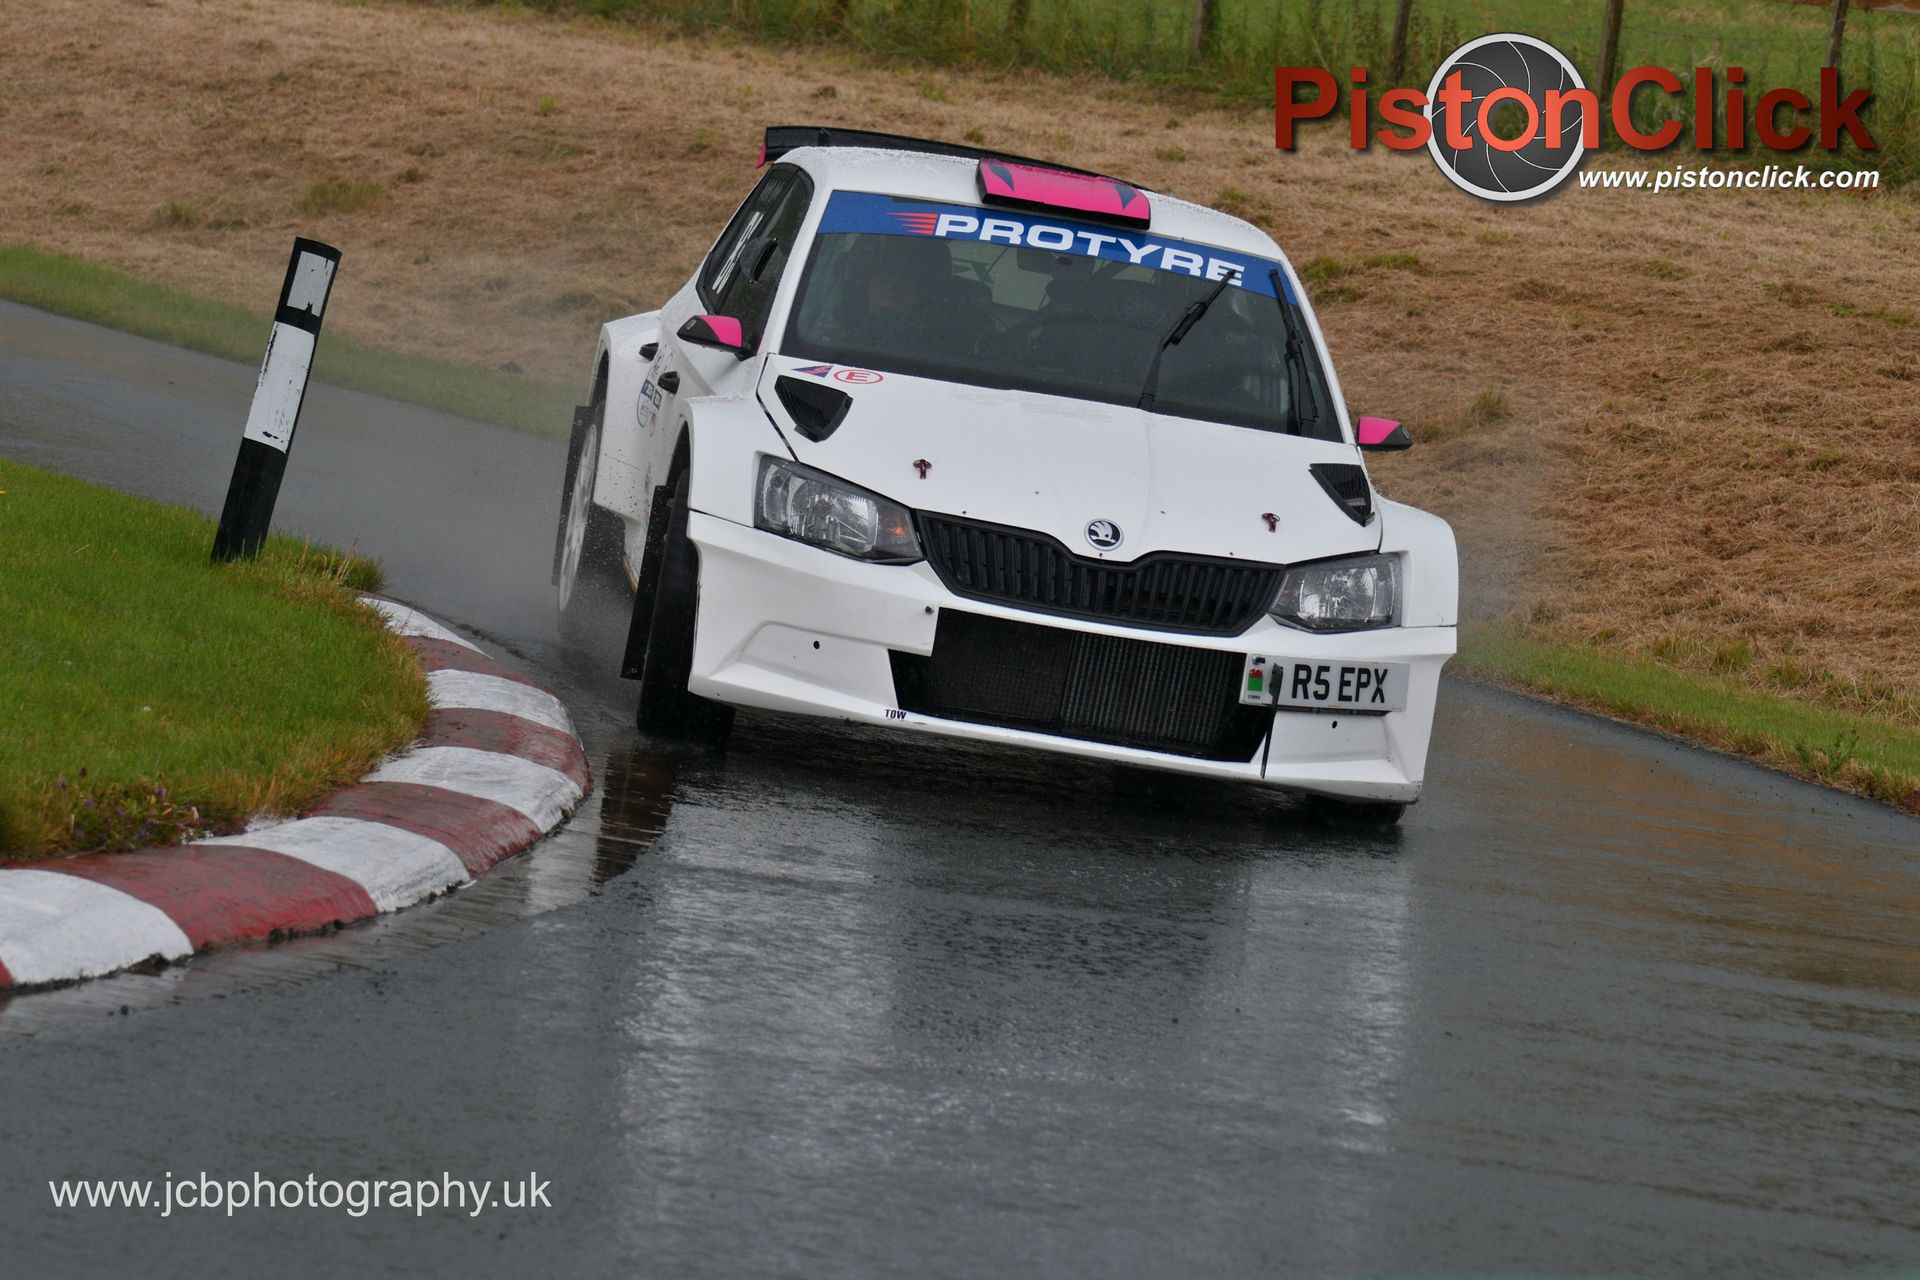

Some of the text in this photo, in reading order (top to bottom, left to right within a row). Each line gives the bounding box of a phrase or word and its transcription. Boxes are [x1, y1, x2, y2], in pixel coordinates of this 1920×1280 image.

[935, 213, 1245, 287] PROTYRE
[845, 371, 871, 382] E
[1291, 664, 1388, 704] R5 EPX
[885, 708, 907, 720] TOW
